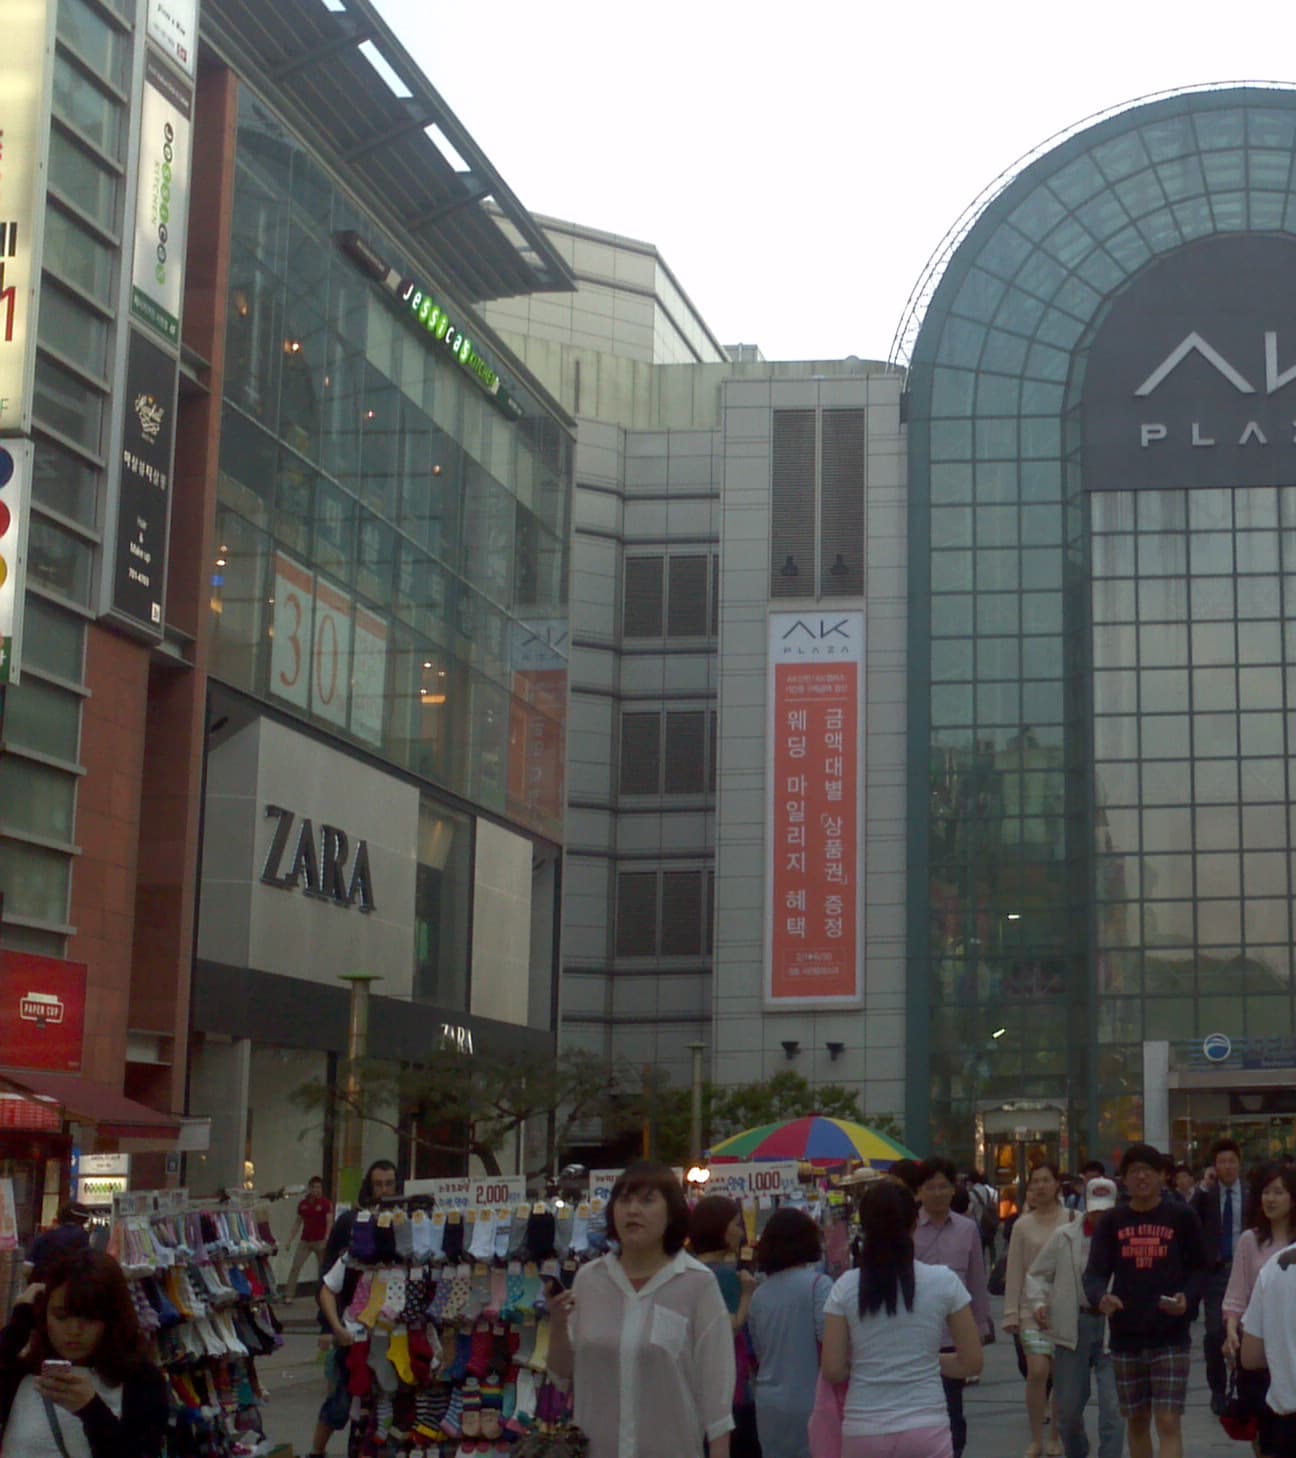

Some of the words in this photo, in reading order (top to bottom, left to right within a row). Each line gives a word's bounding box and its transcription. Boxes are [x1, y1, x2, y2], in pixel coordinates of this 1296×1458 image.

[782, 618, 851, 639] AK
[783, 645, 849, 655] PLAZA
[787, 709, 808, 759] 웨딩
[824, 708, 845, 802] 금액대별
[786, 774, 808, 874] 마일리지
[259, 803, 377, 915] ZARA
[823, 894, 845, 940] 증정
[23, 1003, 46, 1016] PAPER
[46, 1005, 60, 1018] CUP
[439, 1023, 475, 1056] ZARA
[748, 1171, 780, 1193] 1,000
